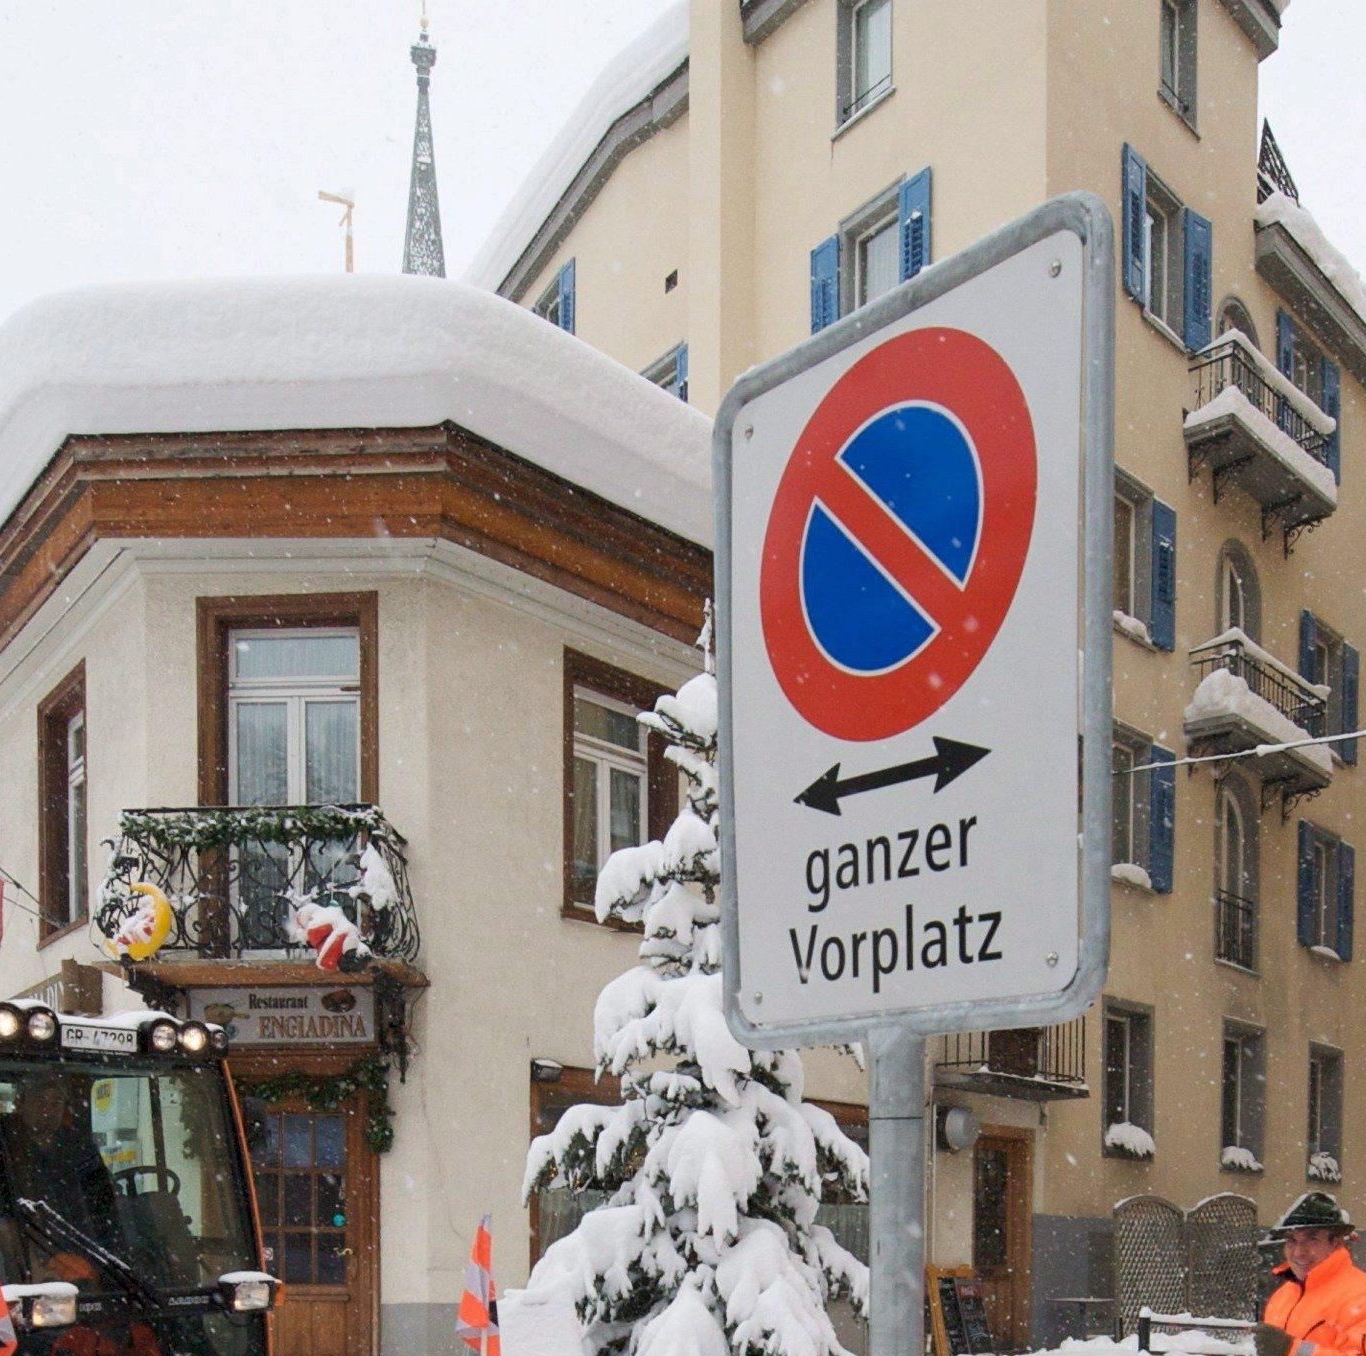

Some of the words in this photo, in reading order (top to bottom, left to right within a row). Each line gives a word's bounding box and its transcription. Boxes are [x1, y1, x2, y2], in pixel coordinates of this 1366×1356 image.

[805, 815, 978, 913] ganzer
[789, 904, 1003, 993] Vorplatz
[248, 993, 308, 1009] Restaurant
[257, 1014, 368, 1039] ENGIADINA
